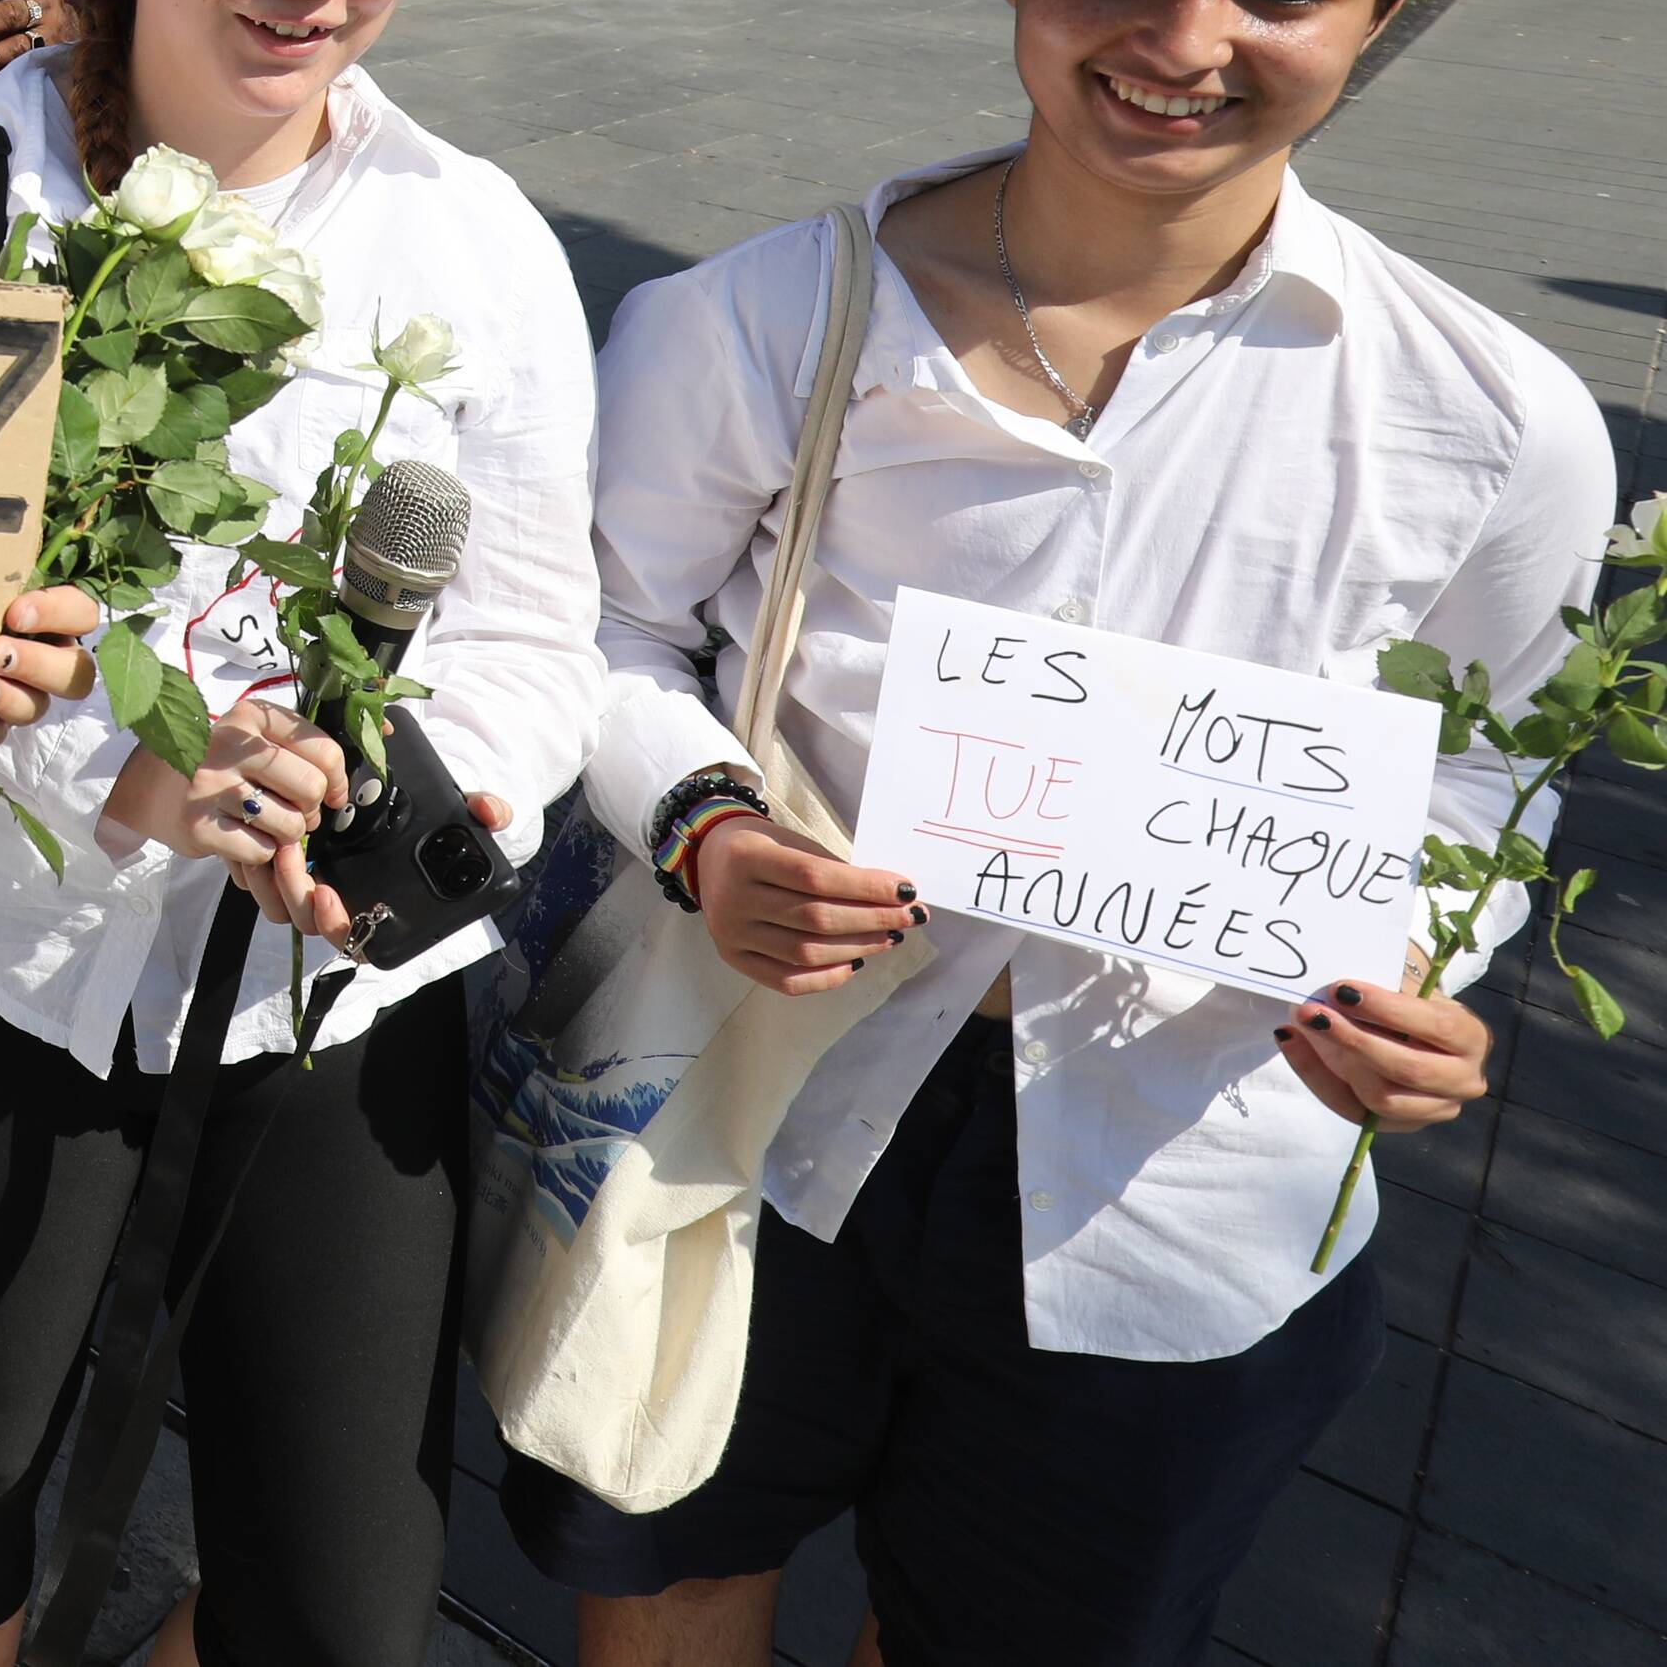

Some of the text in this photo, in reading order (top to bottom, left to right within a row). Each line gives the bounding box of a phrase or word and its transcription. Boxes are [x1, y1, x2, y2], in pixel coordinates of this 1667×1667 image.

[937, 628, 1349, 793] LES MOTS
[918, 725, 1413, 906] TUE CHAQUE
[974, 850, 1307, 980] ANNÉES
